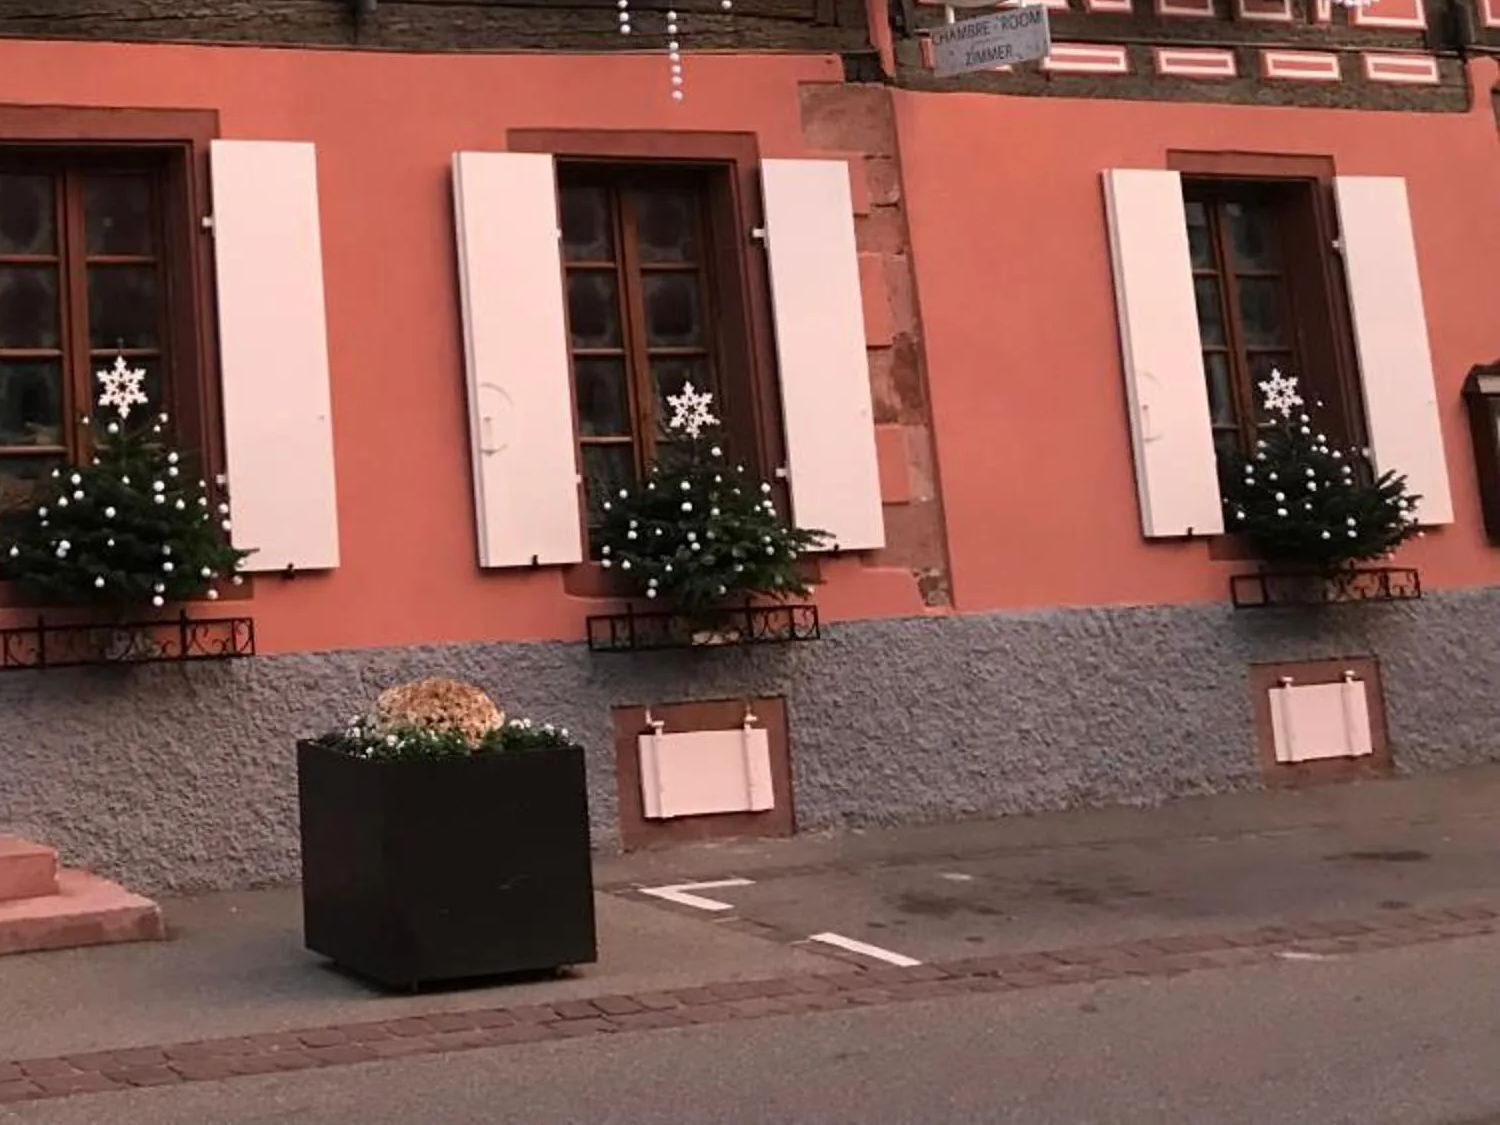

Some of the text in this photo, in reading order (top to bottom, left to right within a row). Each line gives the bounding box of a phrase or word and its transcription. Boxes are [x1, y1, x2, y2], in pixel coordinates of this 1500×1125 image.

[931, 20, 991, 45] CHAMBRE
[1001, 10, 1041, 32] ROOM
[965, 44, 1013, 66] ZIMMER
